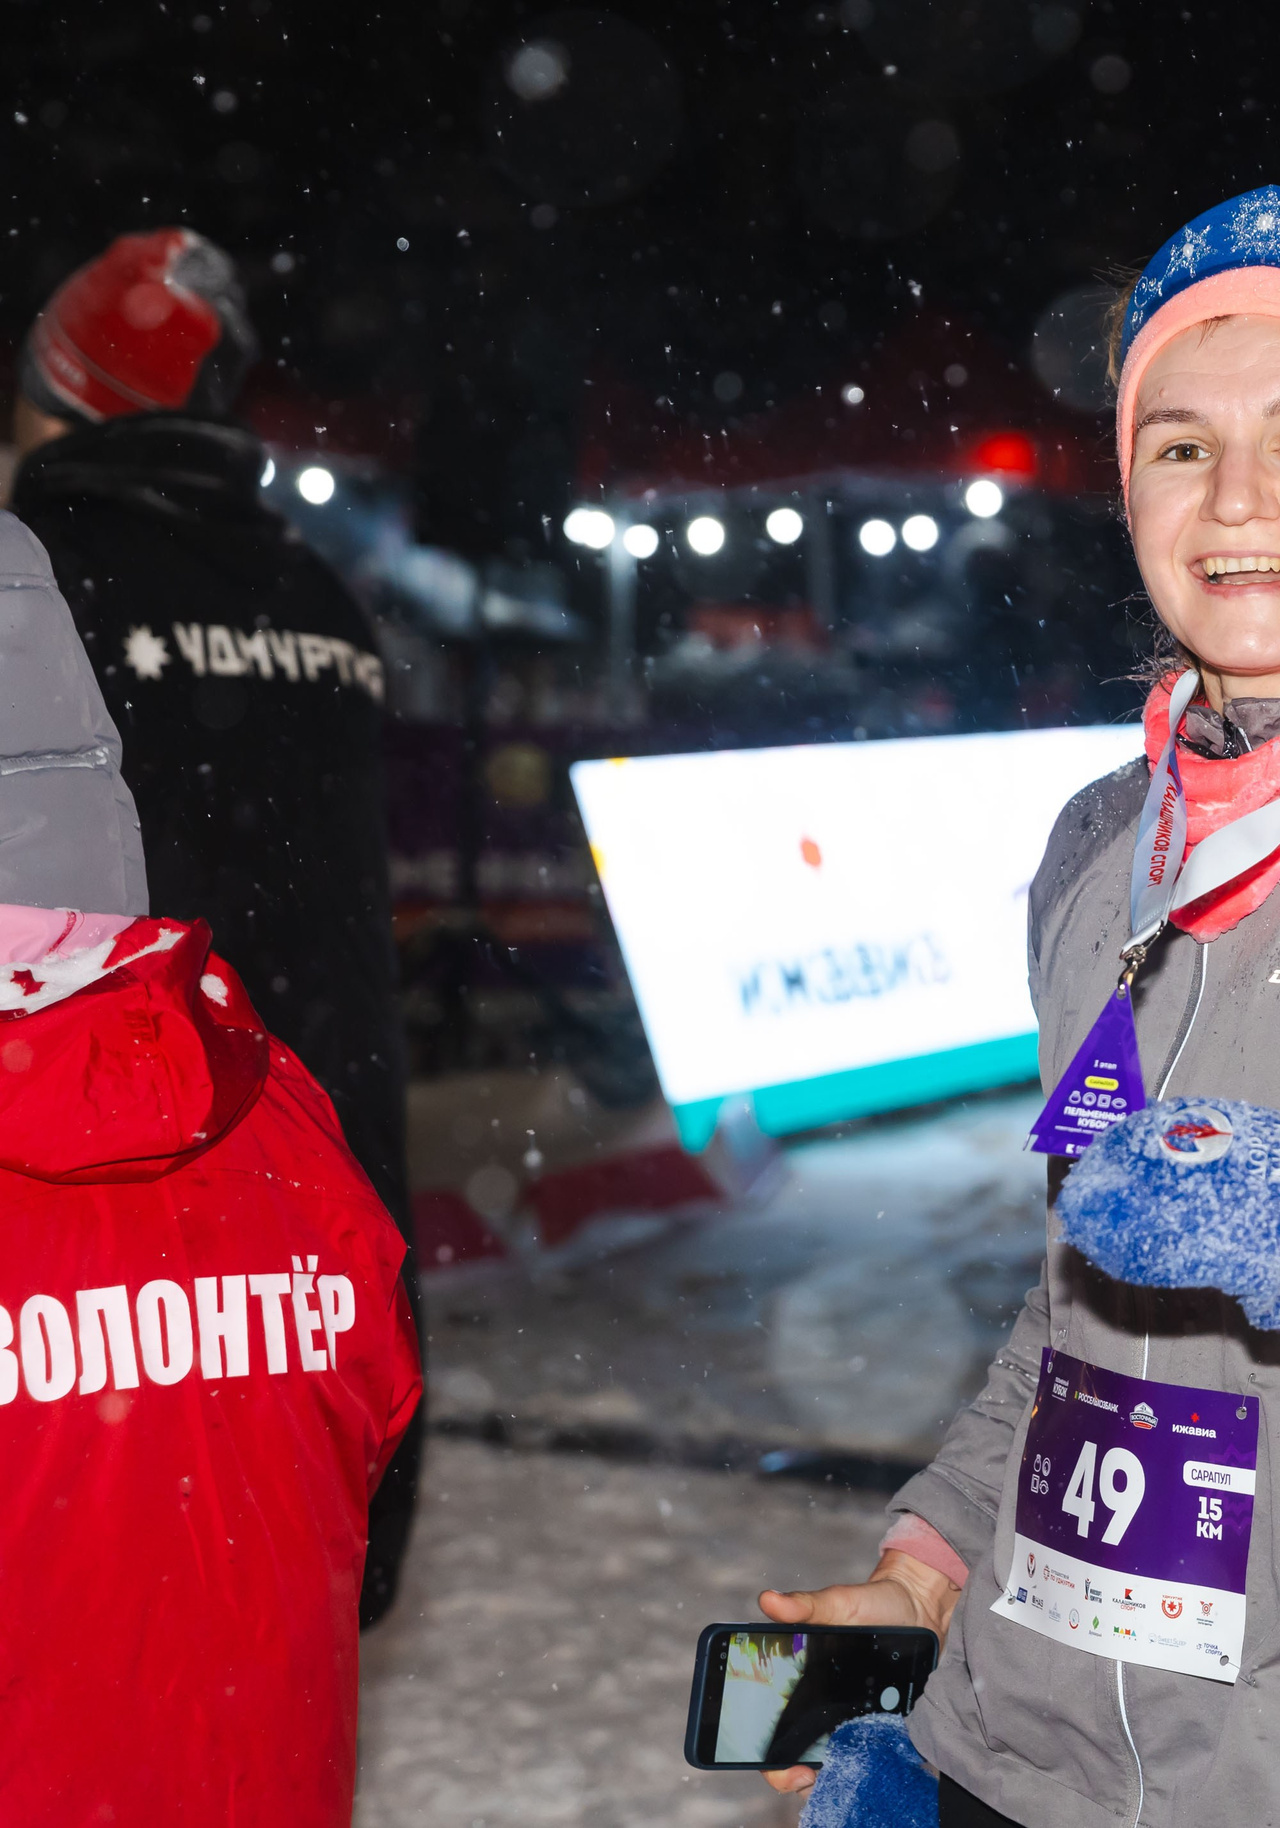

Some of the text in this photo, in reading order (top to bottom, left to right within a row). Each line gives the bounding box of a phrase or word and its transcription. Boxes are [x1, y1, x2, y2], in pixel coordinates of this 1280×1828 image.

[1153, 782, 1177, 851] КАЛАШНИКОВ
[1063, 1105, 1126, 1122] ПЕЛЬМЕННЫЙ
[1077, 1117, 1109, 1129] КУБОК
[1171, 1424, 1217, 1439] ижавиа
[1191, 1468, 1231, 1486] САРАПУЛ
[1061, 1440, 1146, 1546] 49
[1198, 1496, 1223, 1521] 15
[1196, 1520, 1223, 1541] КМ
[1112, 1597, 1146, 1609] КАЛАШНИКОВ
